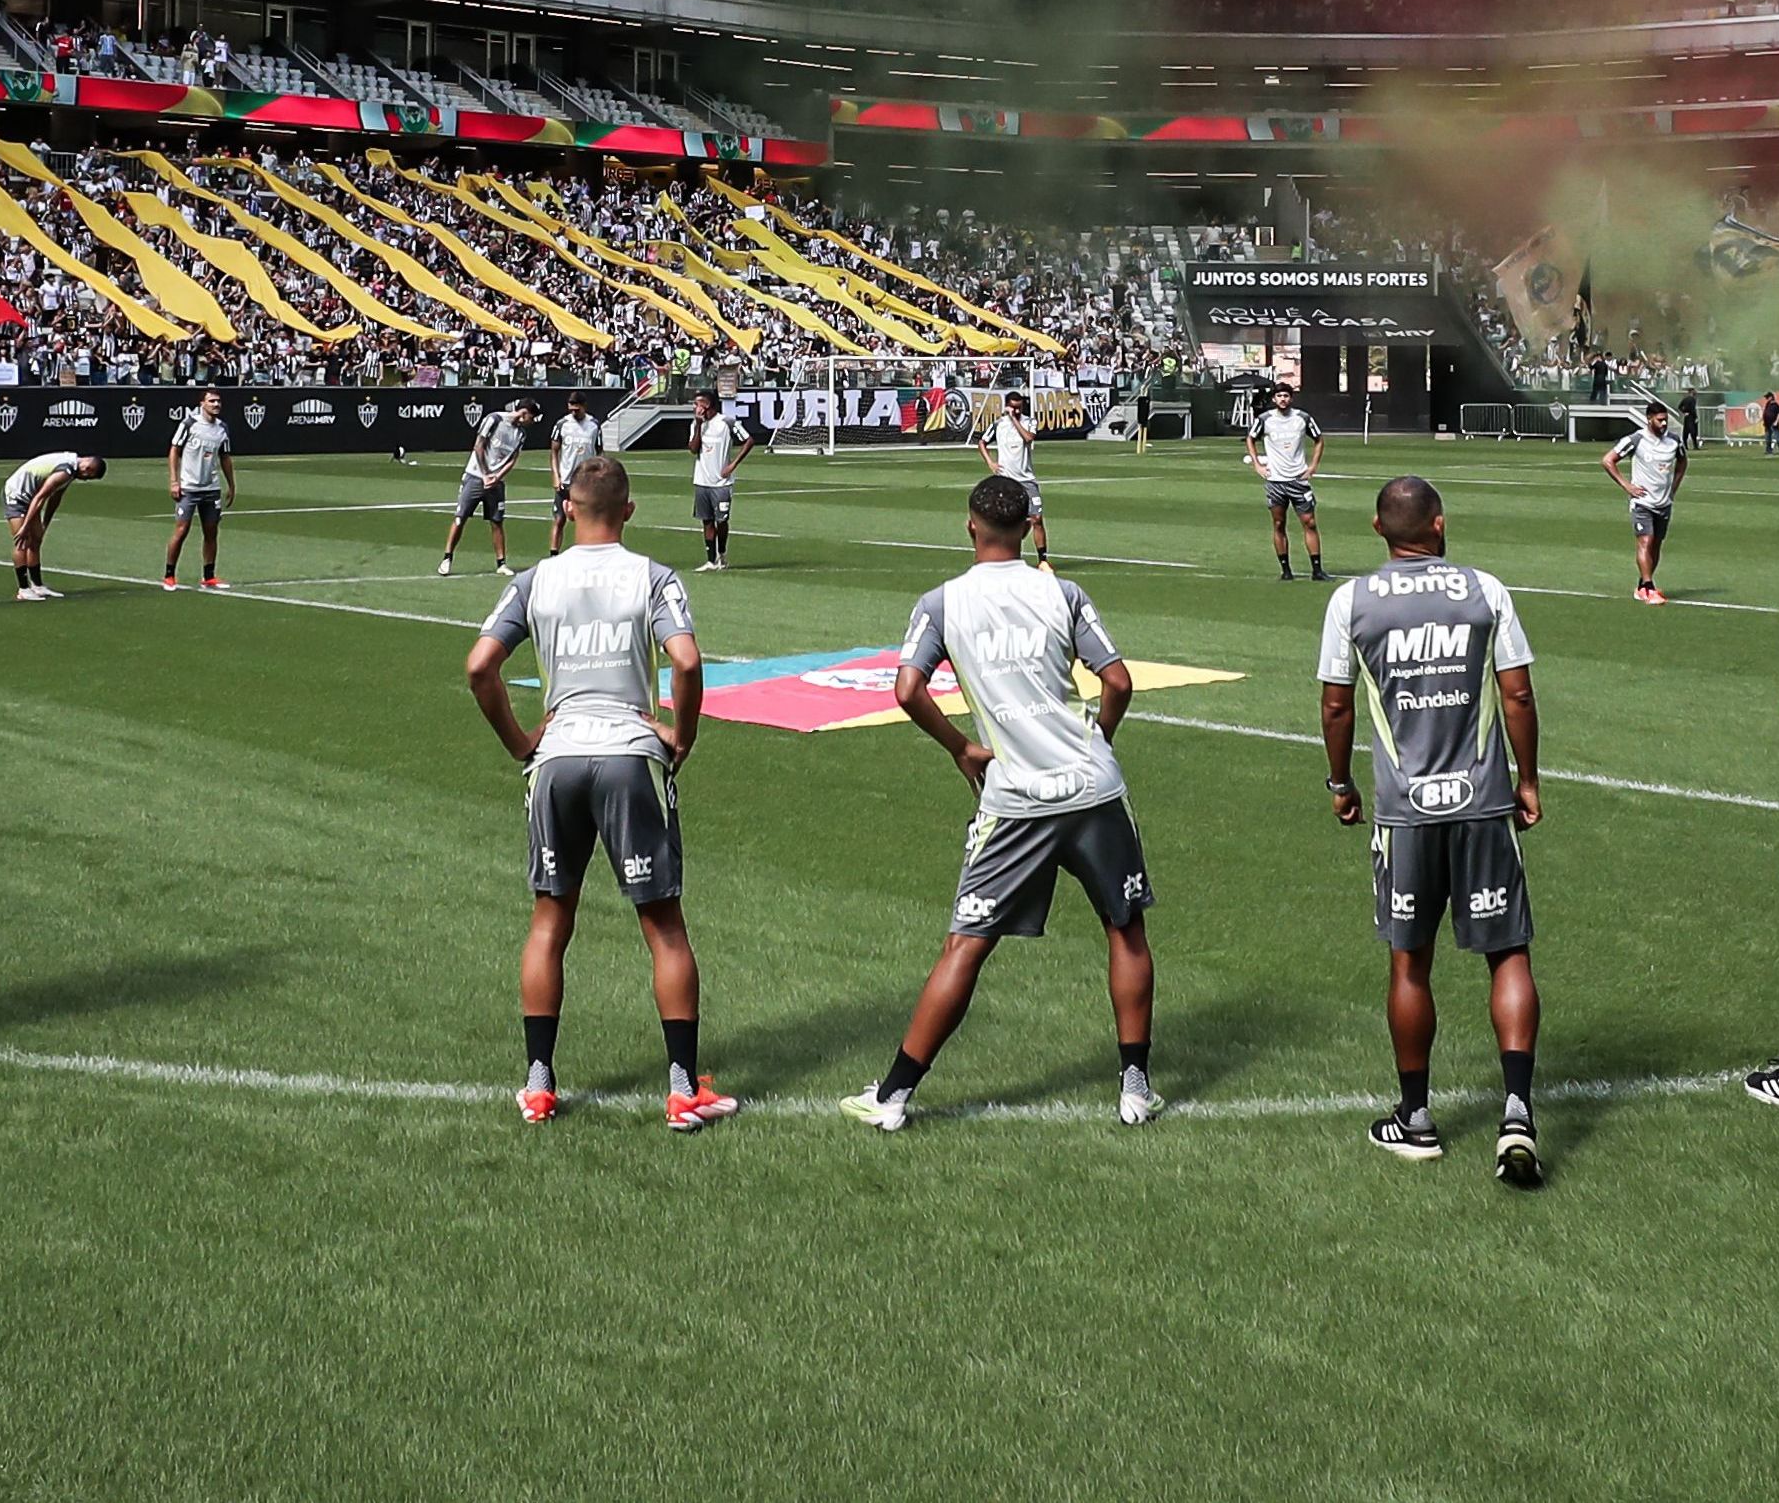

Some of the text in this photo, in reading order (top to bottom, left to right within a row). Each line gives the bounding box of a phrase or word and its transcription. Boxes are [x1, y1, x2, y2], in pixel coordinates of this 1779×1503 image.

[1192, 271, 1428, 287] JUNTOS SOMOS MAIS FORTES
[1207, 306, 1332, 318] AQUI É A
[1210, 316, 1399, 327] NOSSA CASA
[410, 404, 445, 418] MRV
[721, 389, 901, 430] FURIA
[1390, 571, 1469, 601] bmg
[1389, 666, 1424, 680] Aluguel
[1425, 665, 1438, 676] de
[1395, 689, 1470, 712] mundiale
[1037, 776, 1077, 799] BH
[1421, 782, 1462, 808] BH
[623, 854, 653, 878] abc
[956, 892, 997, 917] abc
[1469, 886, 1508, 912] abc
